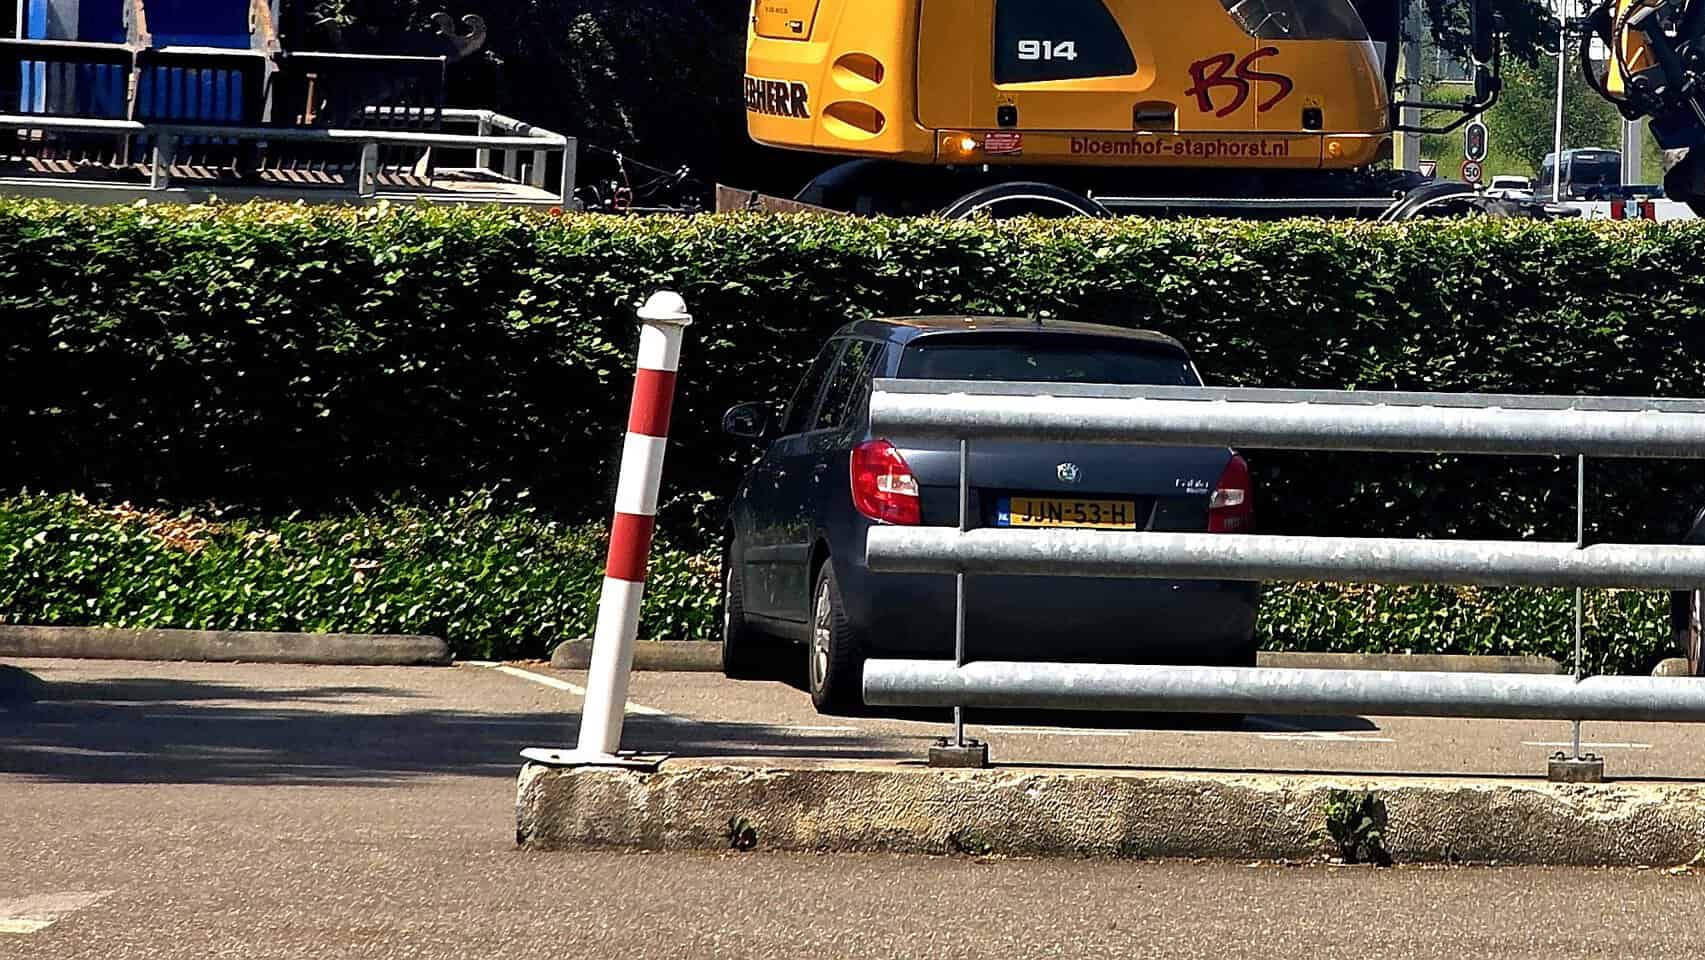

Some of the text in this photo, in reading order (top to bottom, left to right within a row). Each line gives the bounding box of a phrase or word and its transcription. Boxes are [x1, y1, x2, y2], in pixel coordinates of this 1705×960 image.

[1018, 40, 1078, 61] 914
[1184, 47, 1293, 118] BS
[1070, 137, 1289, 158] bloemhof-staphorst.nl
[1466, 167, 1479, 177] 50
[1021, 501, 1126, 525] JJN-53-H
